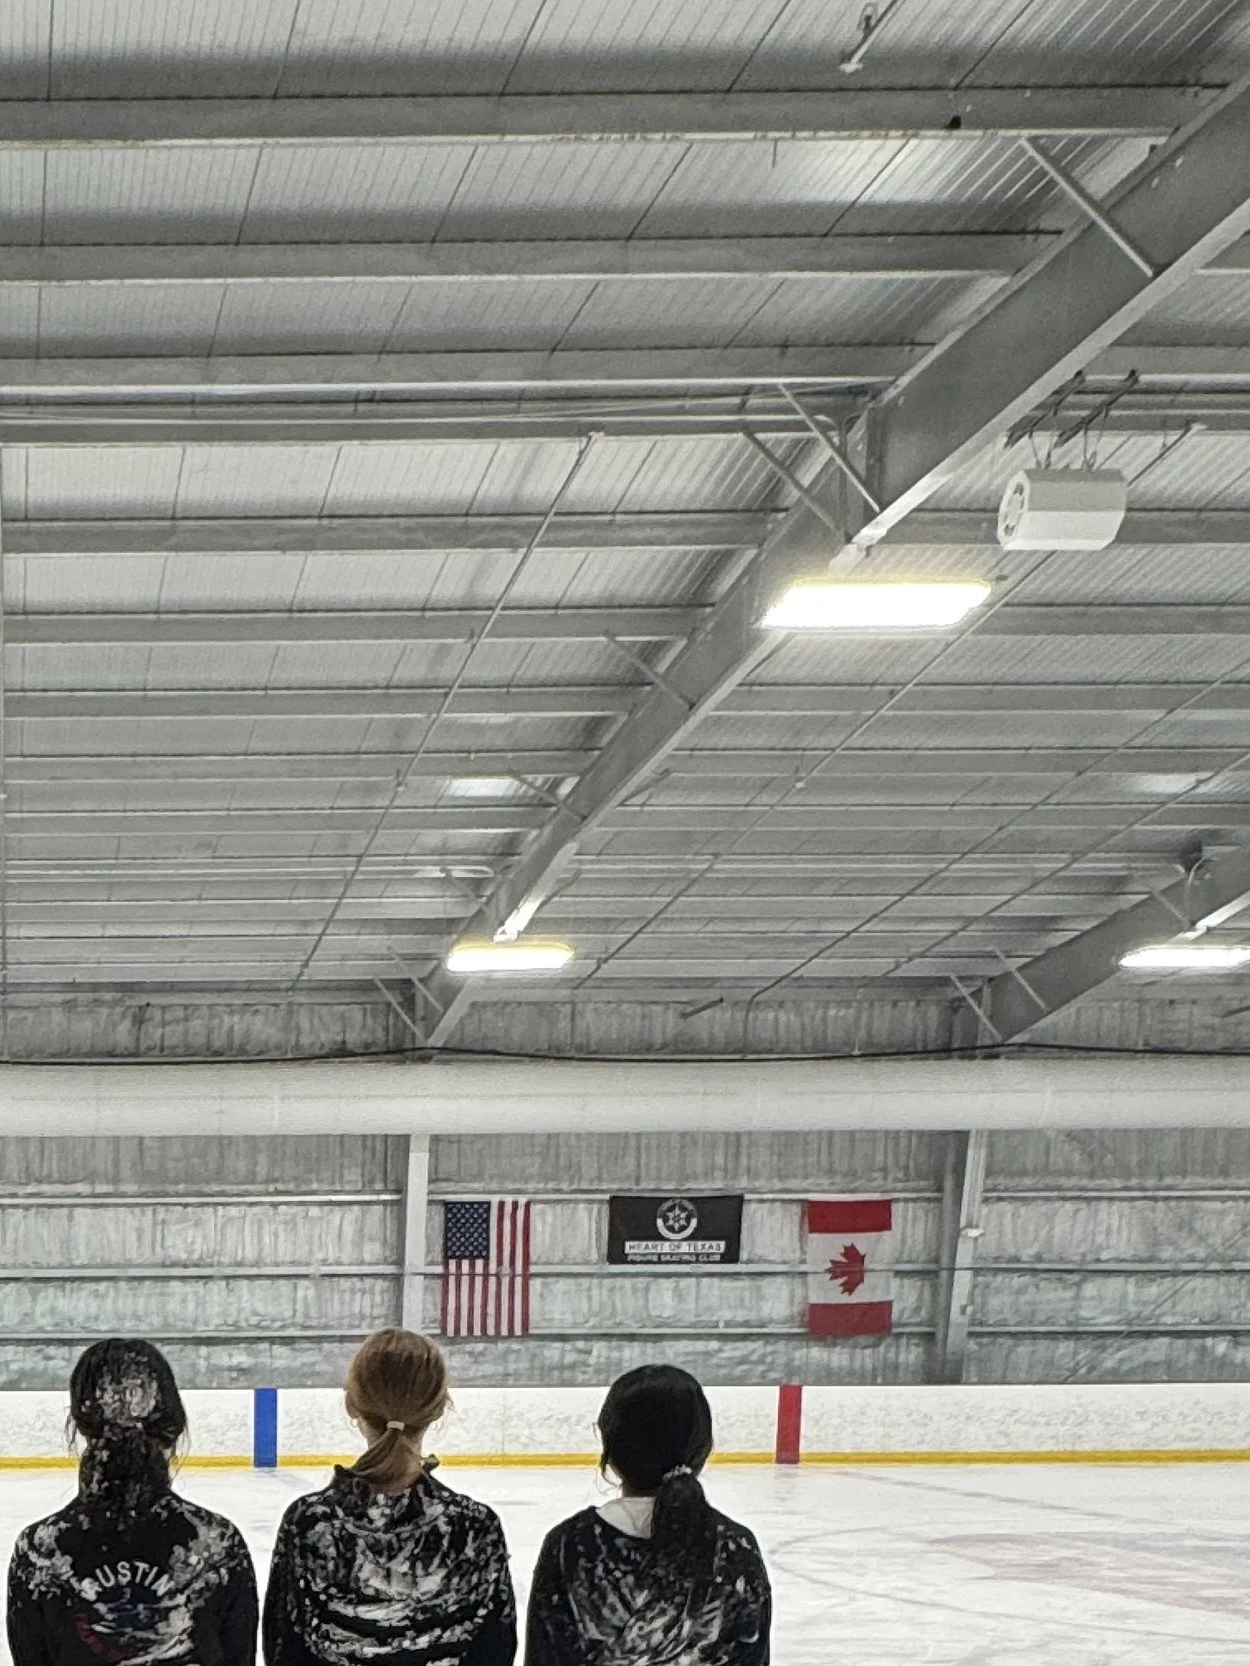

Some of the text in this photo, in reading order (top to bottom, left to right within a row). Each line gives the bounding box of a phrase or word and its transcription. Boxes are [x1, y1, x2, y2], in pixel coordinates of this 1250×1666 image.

[627, 1242, 664, 1252] HEART
[688, 1242, 722, 1252] TEXAS
[79, 1561, 175, 1601] USTIN
